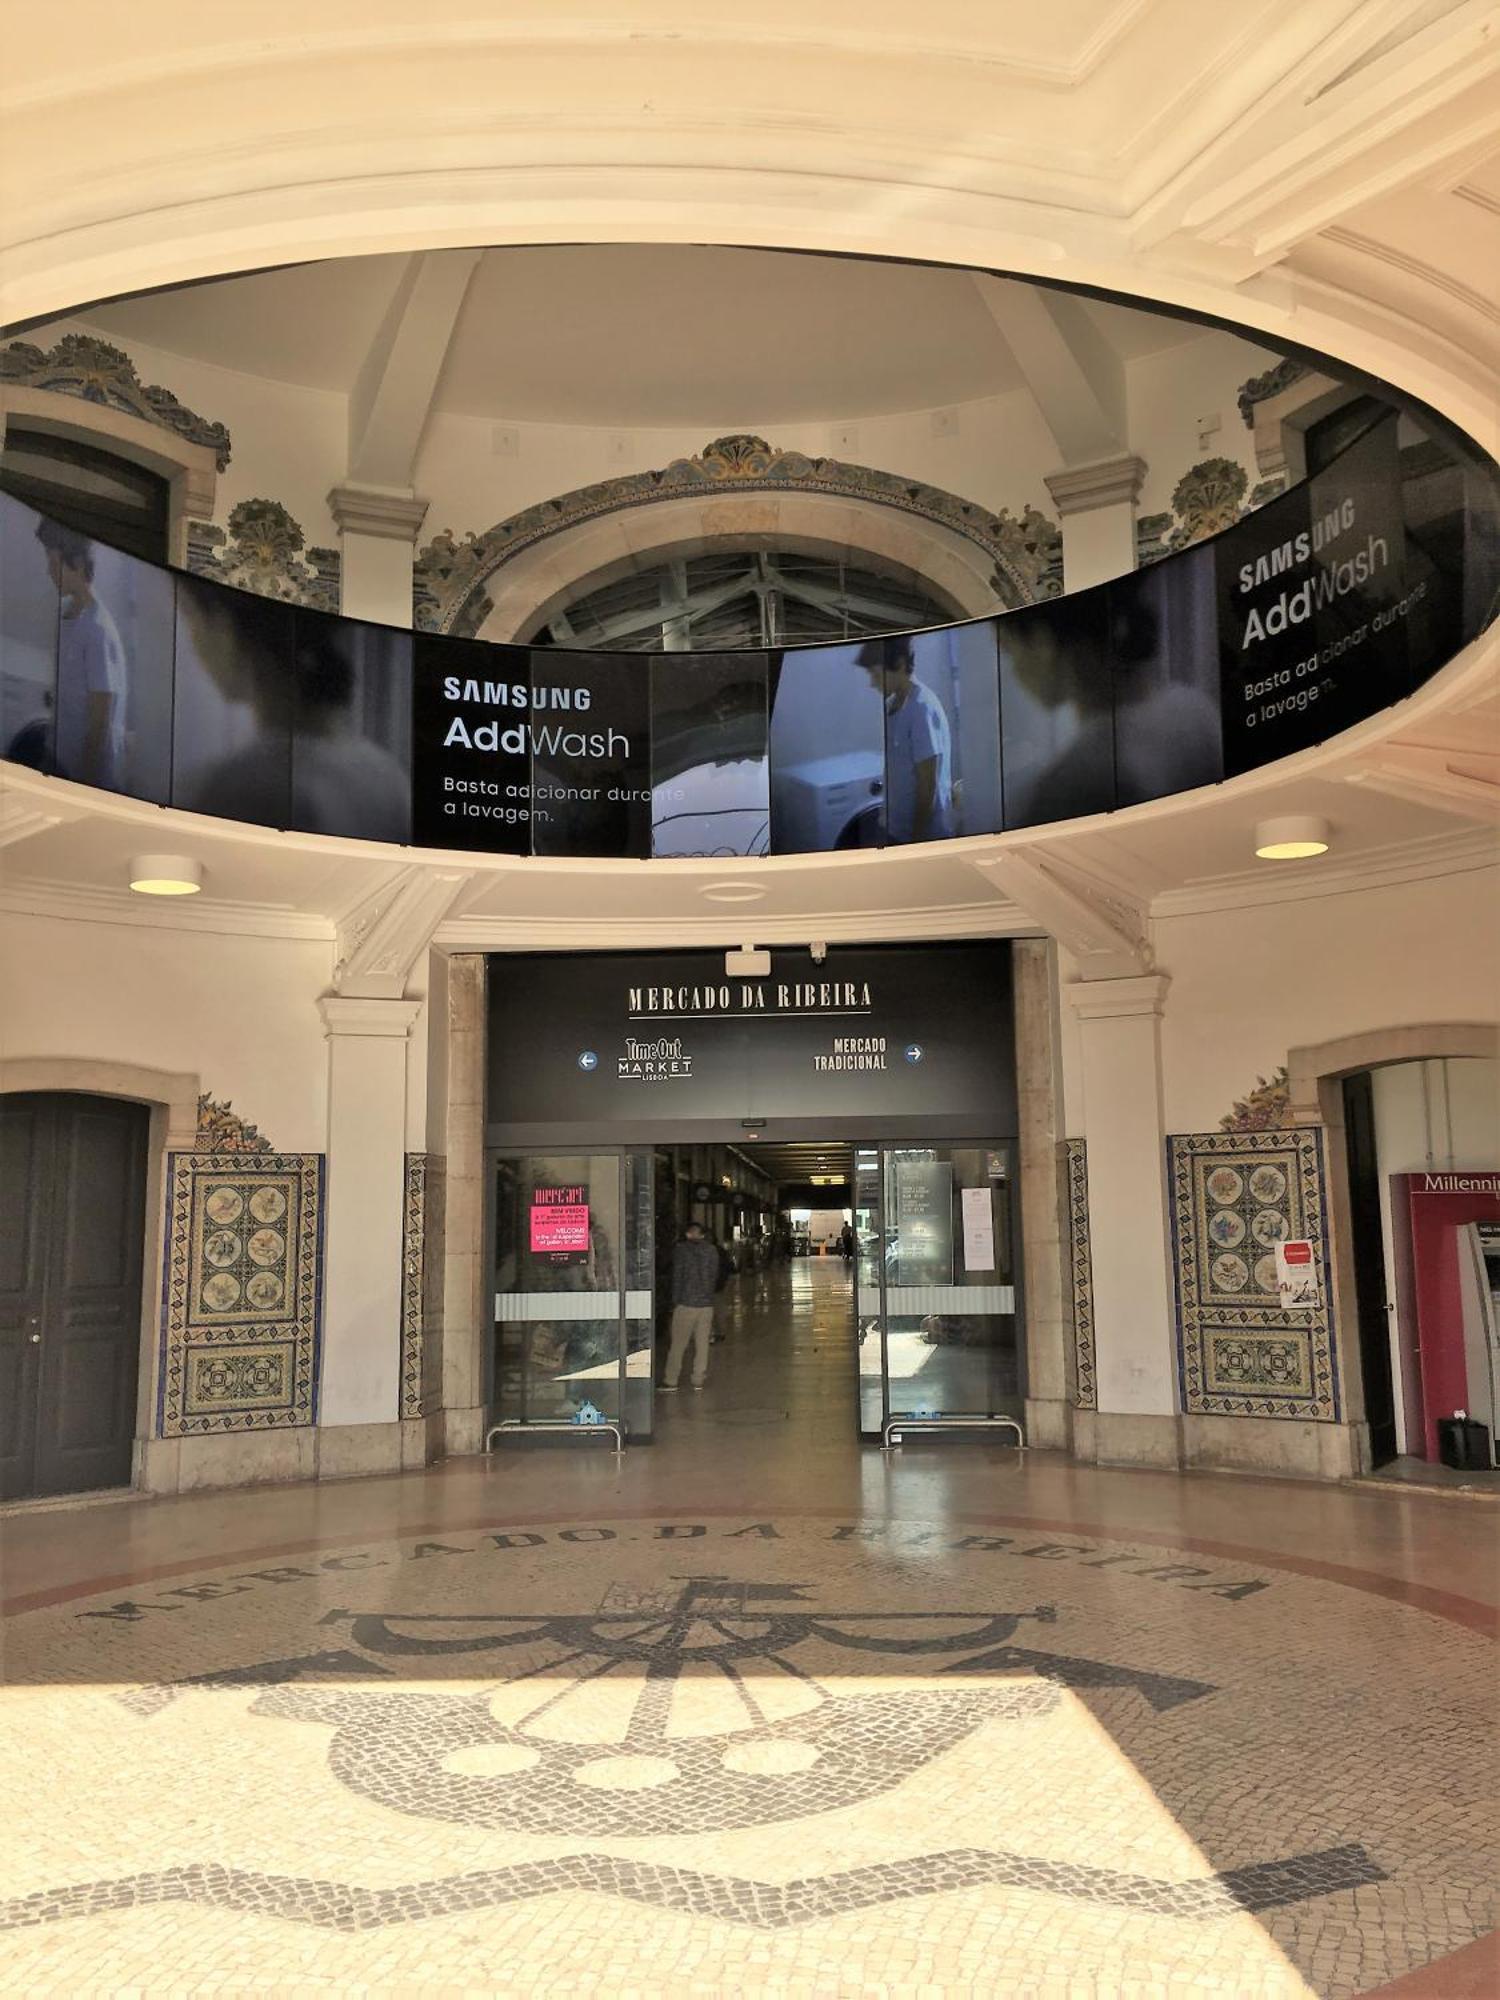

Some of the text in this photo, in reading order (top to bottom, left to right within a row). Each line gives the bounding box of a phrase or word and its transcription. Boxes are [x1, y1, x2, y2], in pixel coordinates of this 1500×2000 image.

[1239, 498, 1355, 593] SAMSUNG
[1241, 534, 1388, 650] AddWash
[444, 676, 591, 711] SAMSUNG
[1244, 669, 1291, 700] Basta
[1246, 713, 1257, 727] a
[443, 716, 630, 758] AddWash
[444, 777, 499, 796] Basta
[444, 802, 554, 824] a lavagem.
[628, 982, 871, 1012] MERCADO DA RIBEIRA
[834, 1038, 886, 1053] MERCADO
[618, 1061, 692, 1074] MARKET
[814, 1055, 887, 1071] TRADICIONAL
[653, 1523, 787, 1539] DA
